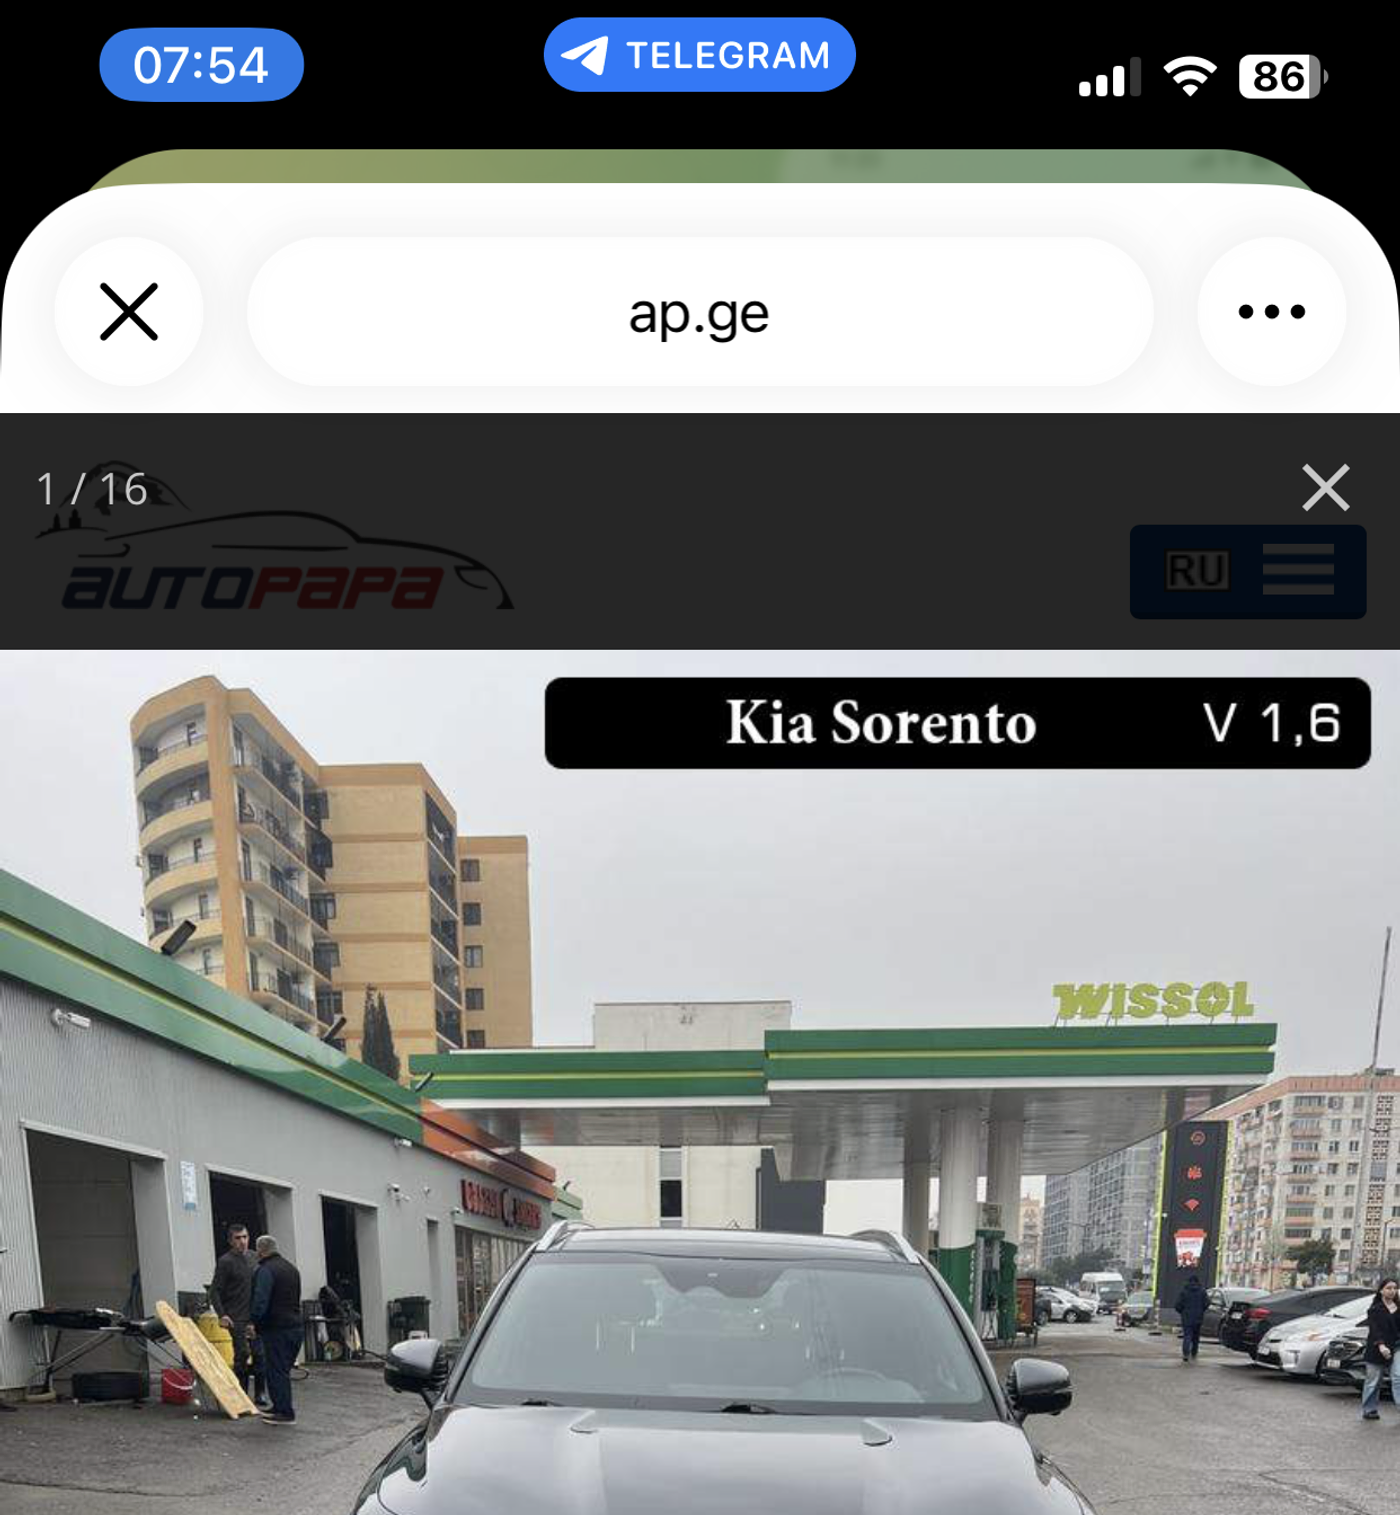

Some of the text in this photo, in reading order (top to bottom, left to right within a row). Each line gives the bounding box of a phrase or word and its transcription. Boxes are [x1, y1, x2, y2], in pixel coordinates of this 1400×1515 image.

[132, 46, 269, 86] 07:54
[625, 40, 830, 70] TELEGRAM
[1253, 61, 1305, 93] 86
[629, 300, 770, 344] ap.ge
[38, 473, 51, 505] 1
[101, 473, 148, 505] 16
[1169, 554, 1224, 586] RU
[1053, 981, 1254, 1019] WISSOL
